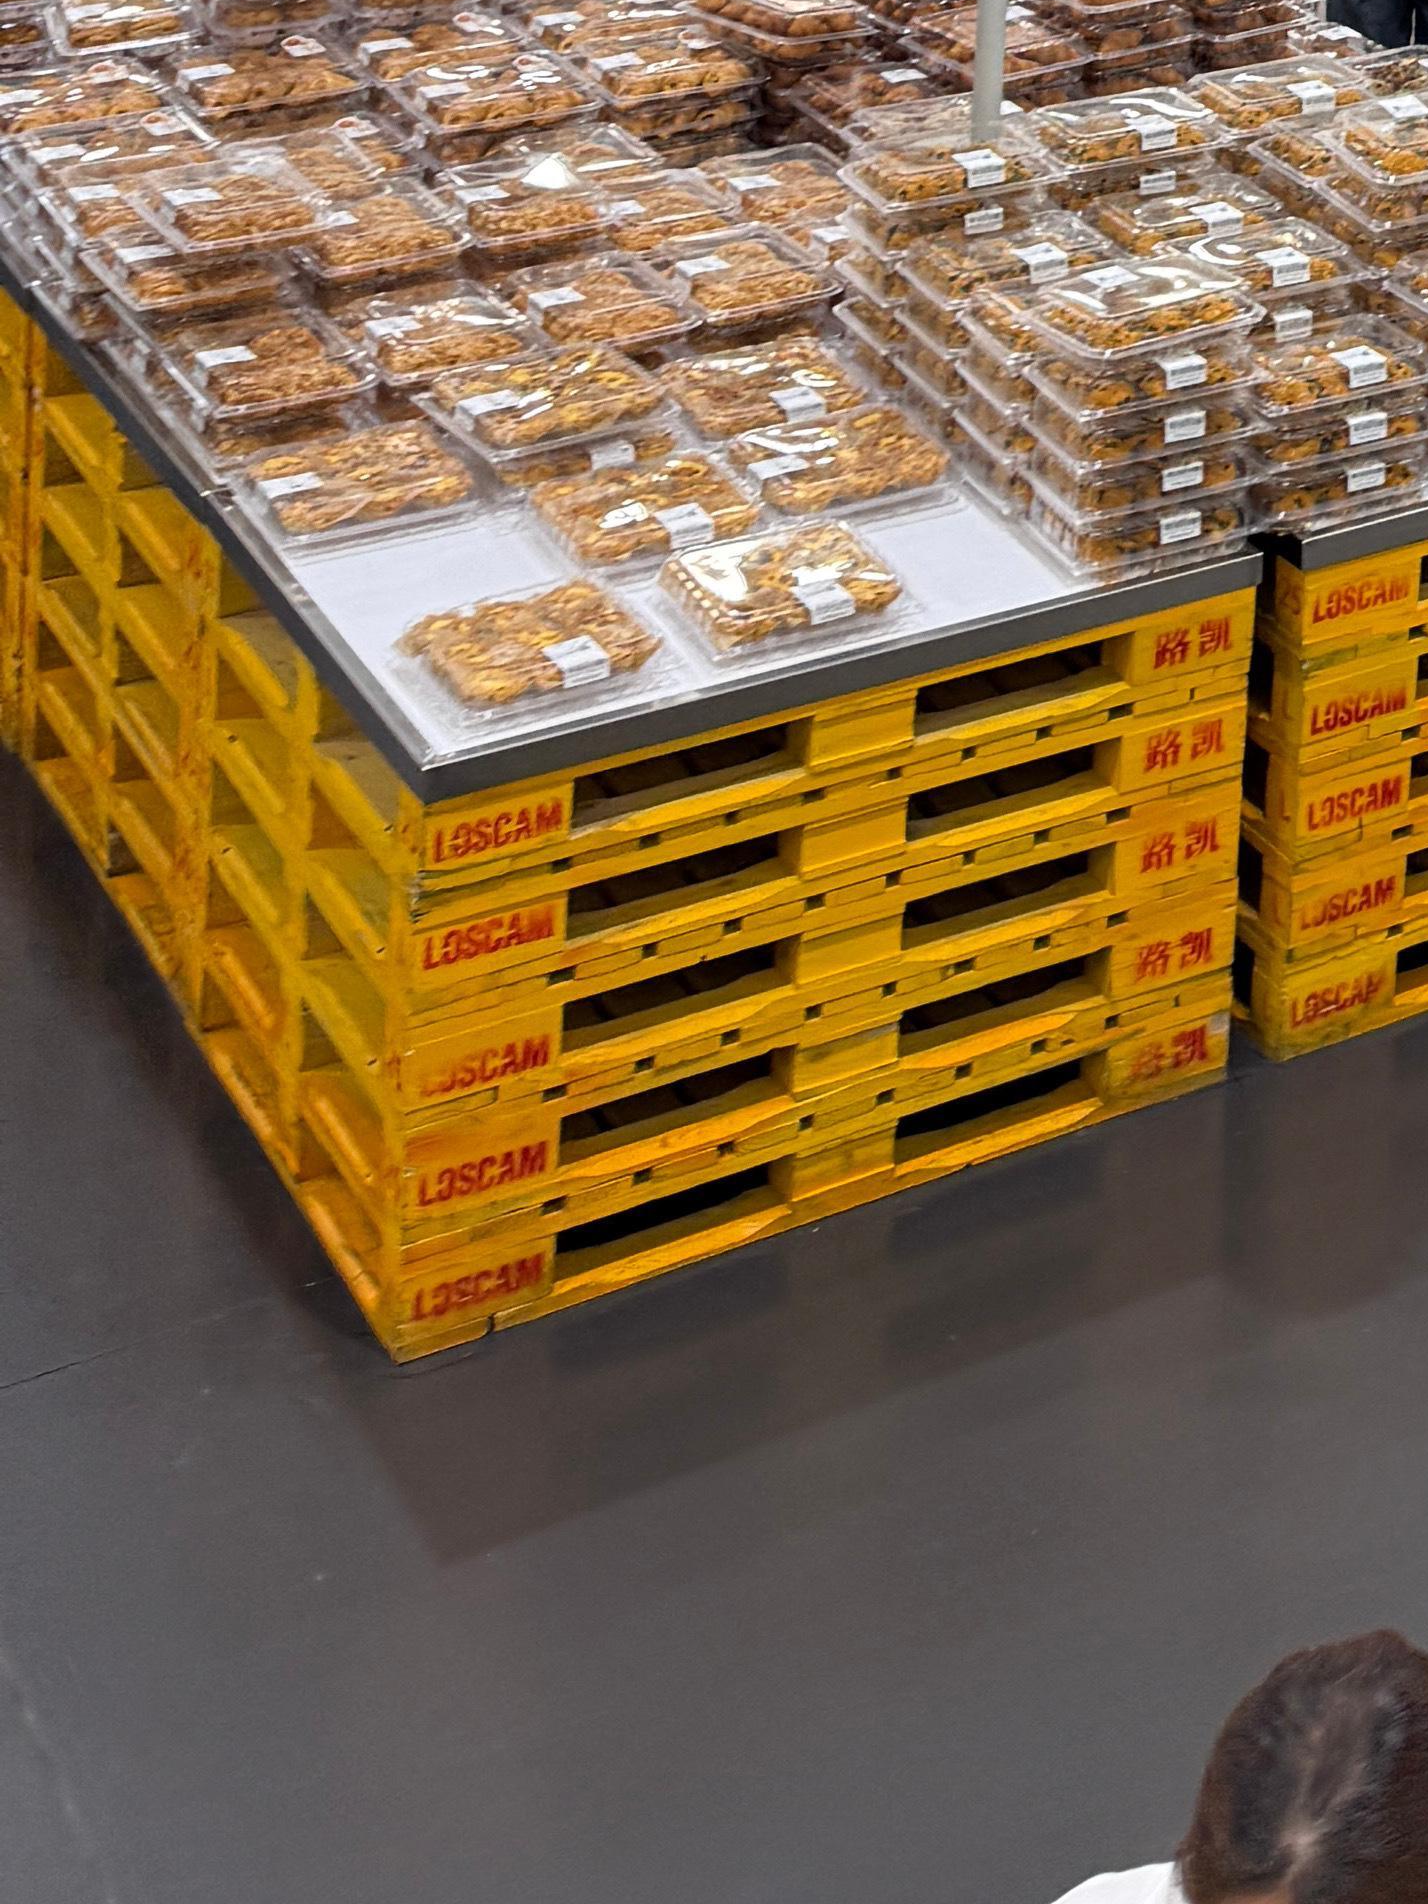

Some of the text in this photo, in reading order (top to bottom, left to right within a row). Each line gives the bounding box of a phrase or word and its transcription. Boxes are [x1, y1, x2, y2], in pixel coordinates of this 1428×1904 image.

[1312, 576, 1411, 624] LOSCAM
[1153, 614, 1234, 669] 路凯
[1310, 685, 1408, 736] LOSCAM
[1144, 716, 1225, 775] 路凯
[433, 798, 564, 864] LOSCAM
[1307, 774, 1403, 832] LOSCAM
[1141, 820, 1221, 874] 路凯
[1299, 875, 1397, 933] LOSCAM
[422, 904, 555, 971] LOSCAM
[1135, 925, 1214, 981] 路凯
[1290, 968, 1385, 1030] LOSCAM
[417, 1140, 548, 1208] LOSCAM
[411, 1251, 545, 1323] LOSCAM
